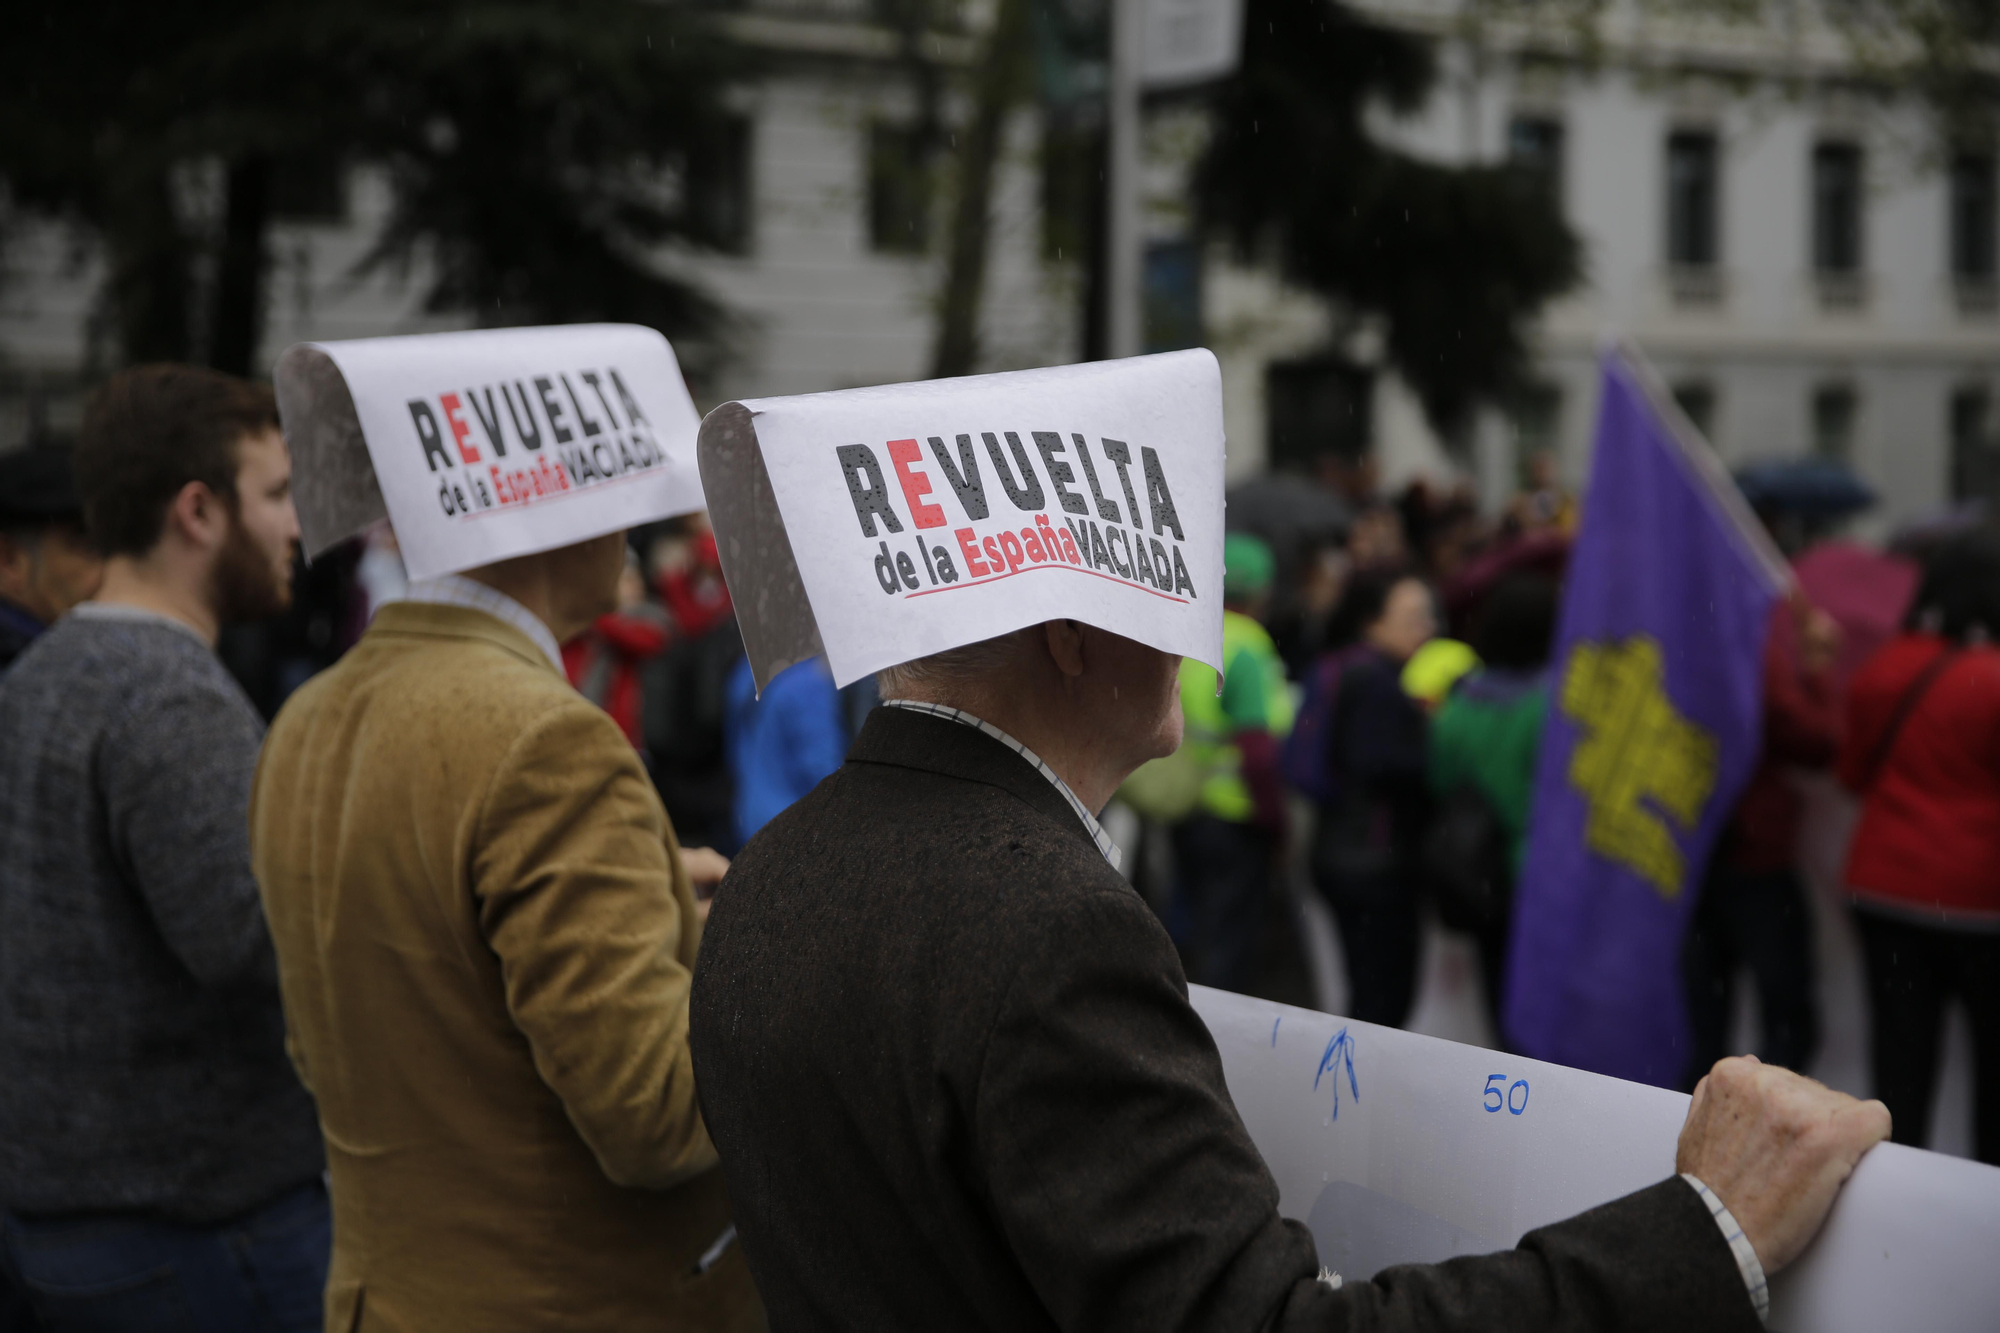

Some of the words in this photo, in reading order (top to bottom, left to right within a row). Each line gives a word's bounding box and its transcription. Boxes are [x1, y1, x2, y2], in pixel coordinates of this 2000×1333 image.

[406, 366, 654, 472] REVUELTA
[438, 475, 468, 516] de
[465, 469, 491, 508] la
[836, 431, 1186, 541] REVUELTA
[874, 541, 921, 595] de
[916, 535, 959, 586] la
[1483, 1074, 1530, 1115] 50
